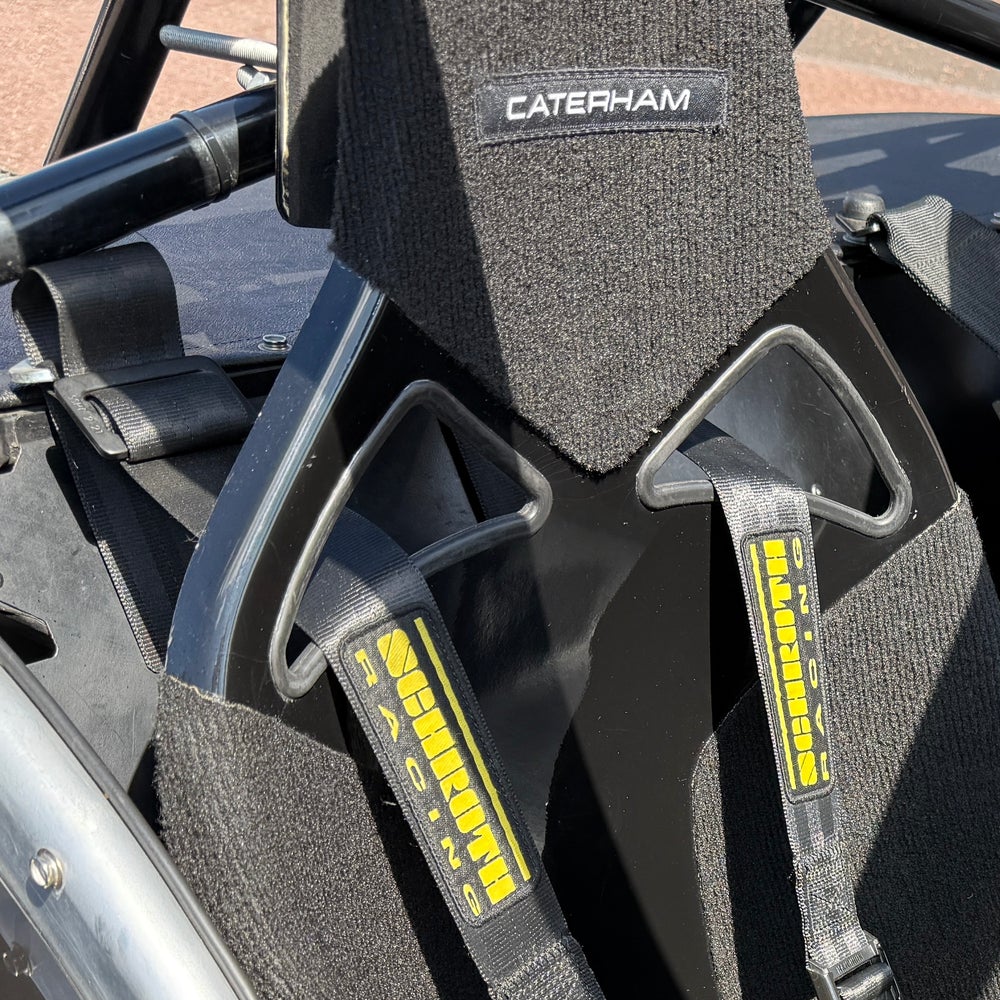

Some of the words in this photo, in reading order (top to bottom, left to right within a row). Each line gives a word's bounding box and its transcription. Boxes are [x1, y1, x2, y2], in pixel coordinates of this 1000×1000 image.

[507, 89, 691, 121] CATERHAM
[355, 648, 482, 917] RACING
[377, 628, 517, 905] SCHROTH
[763, 539, 818, 786] SCHROTH
[792, 537, 829, 781] RACING
